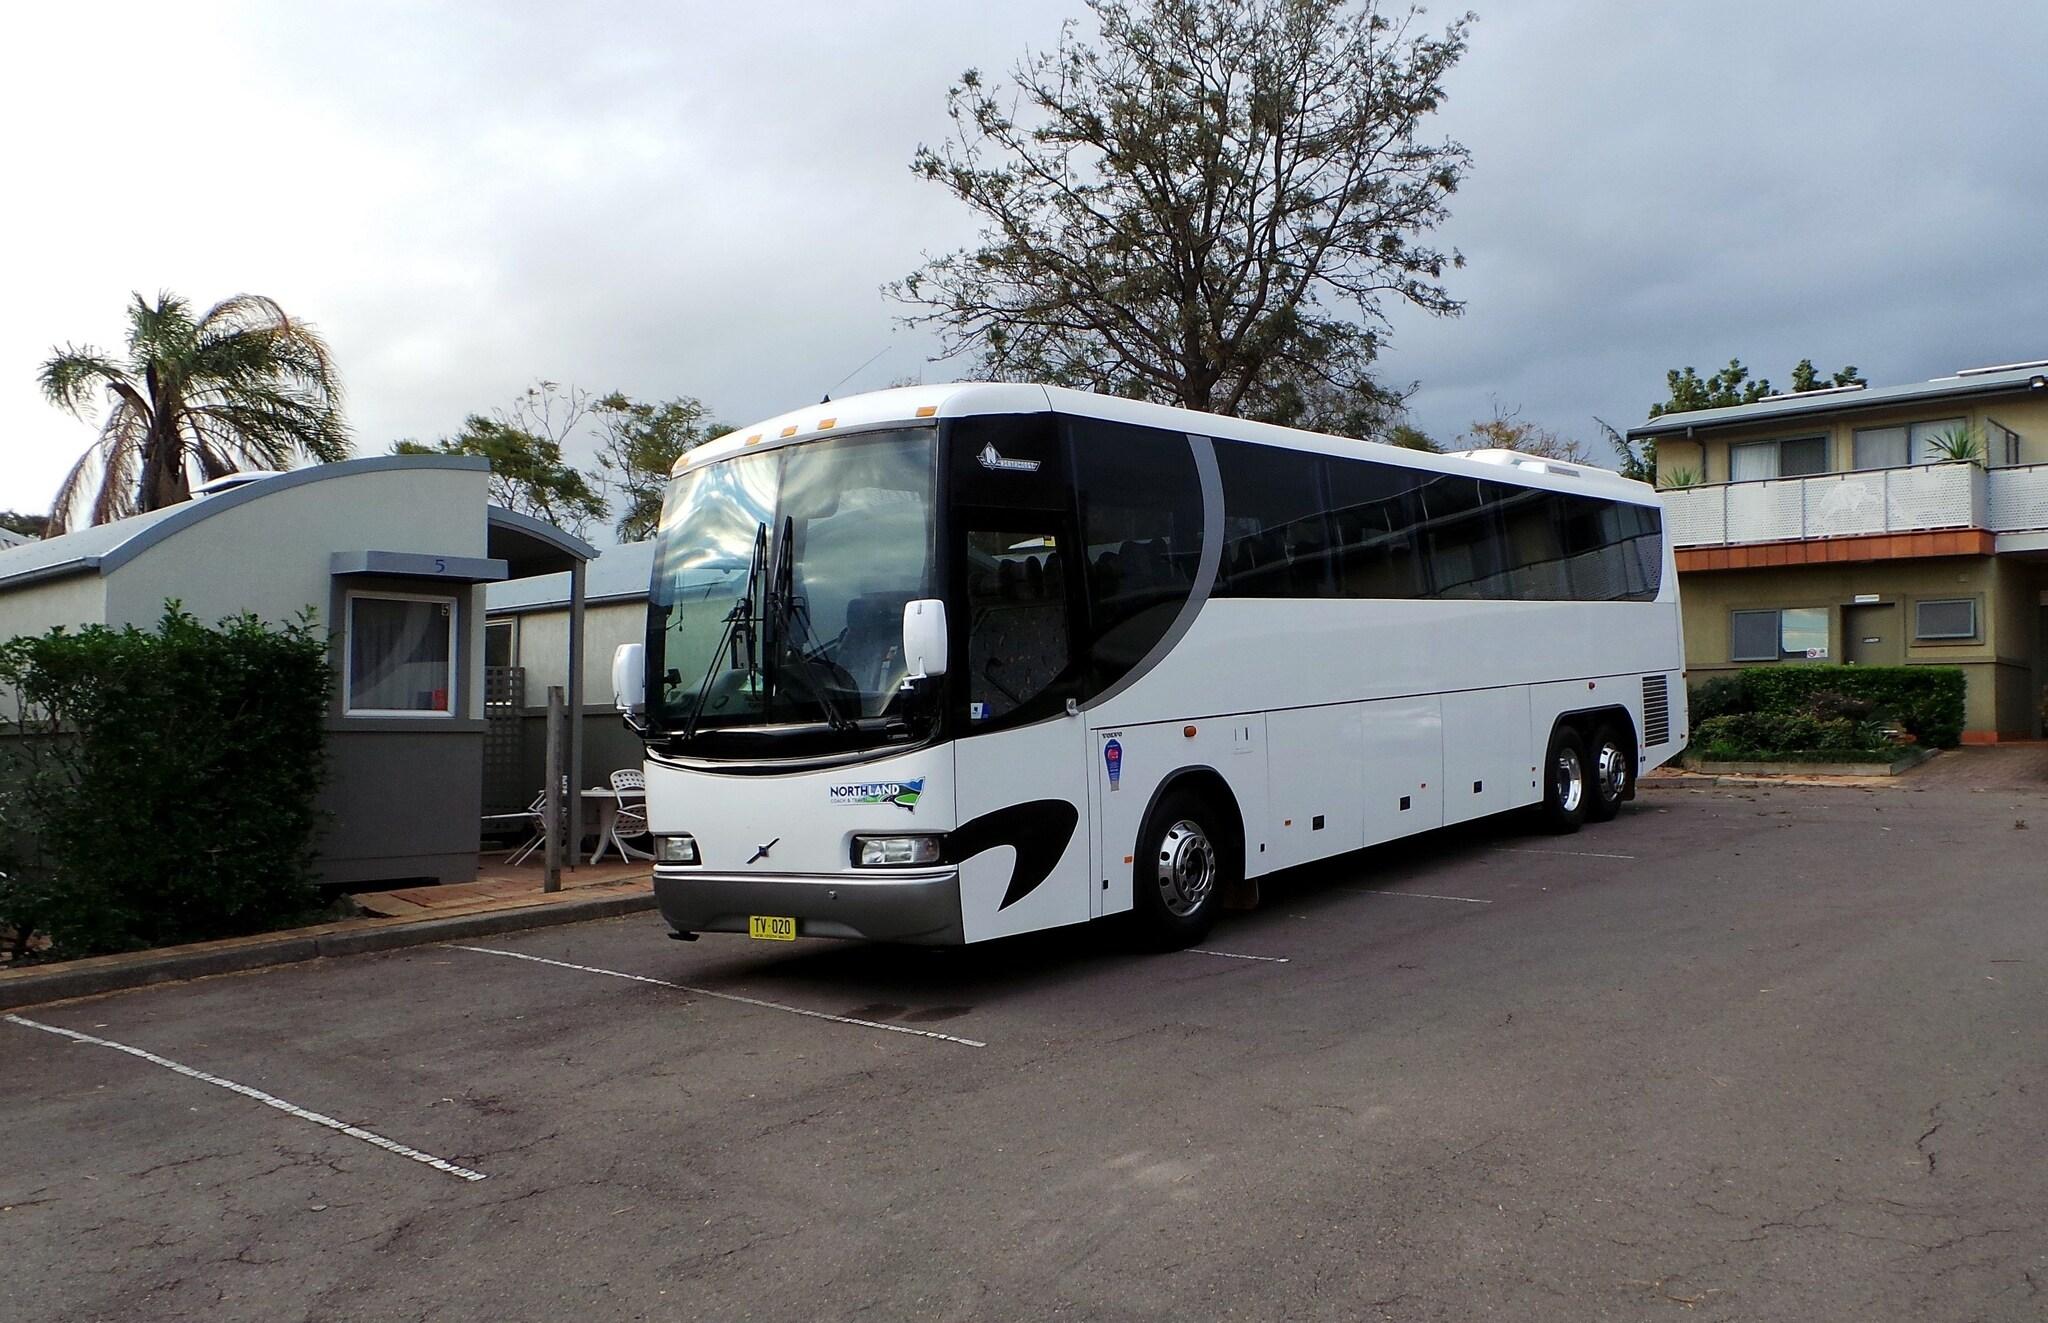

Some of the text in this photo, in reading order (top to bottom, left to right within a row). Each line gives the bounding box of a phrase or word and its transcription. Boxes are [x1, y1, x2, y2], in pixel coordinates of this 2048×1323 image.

[435, 559, 446, 574] 5
[830, 784, 900, 797] NORTHLAND
[754, 918, 791, 935] TV 020
